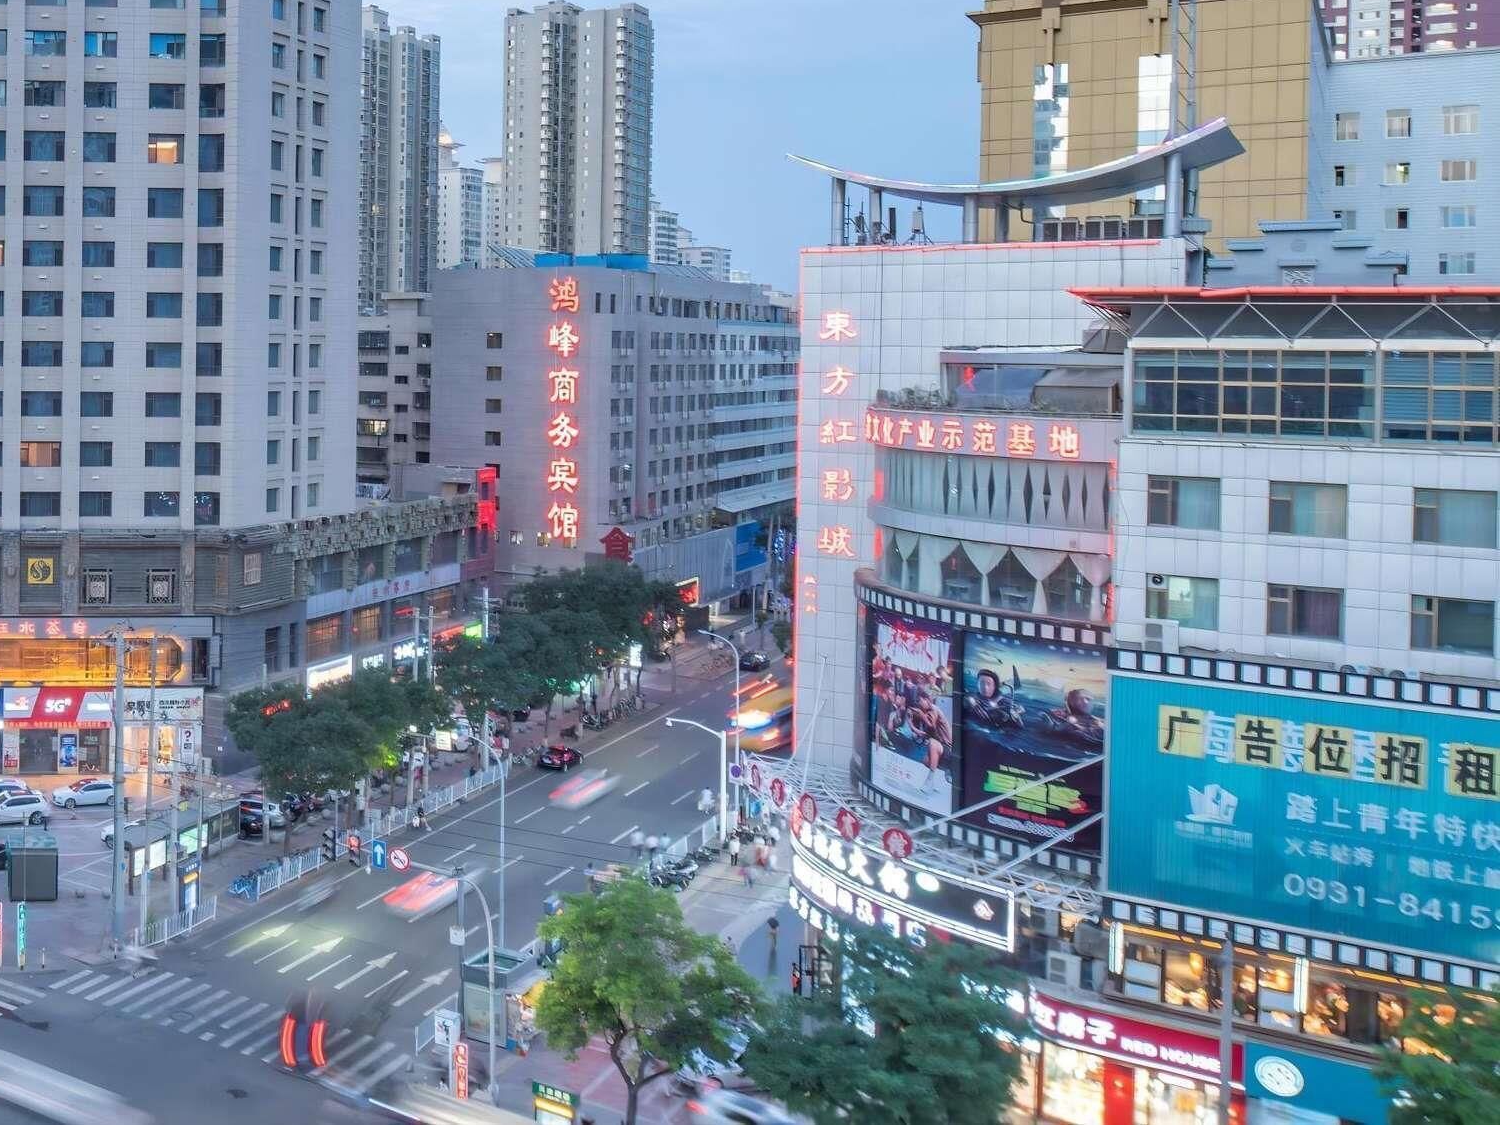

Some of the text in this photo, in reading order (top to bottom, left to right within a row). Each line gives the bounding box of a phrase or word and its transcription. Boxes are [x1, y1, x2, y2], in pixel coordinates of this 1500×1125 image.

[548, 277, 579, 540] 鸿峰商务宾馆
[1162, 710, 1497, 795] 广告位招租
[1285, 792, 1500, 851] 踏上青年特快
[1120, 1037, 1157, 1058] RED
